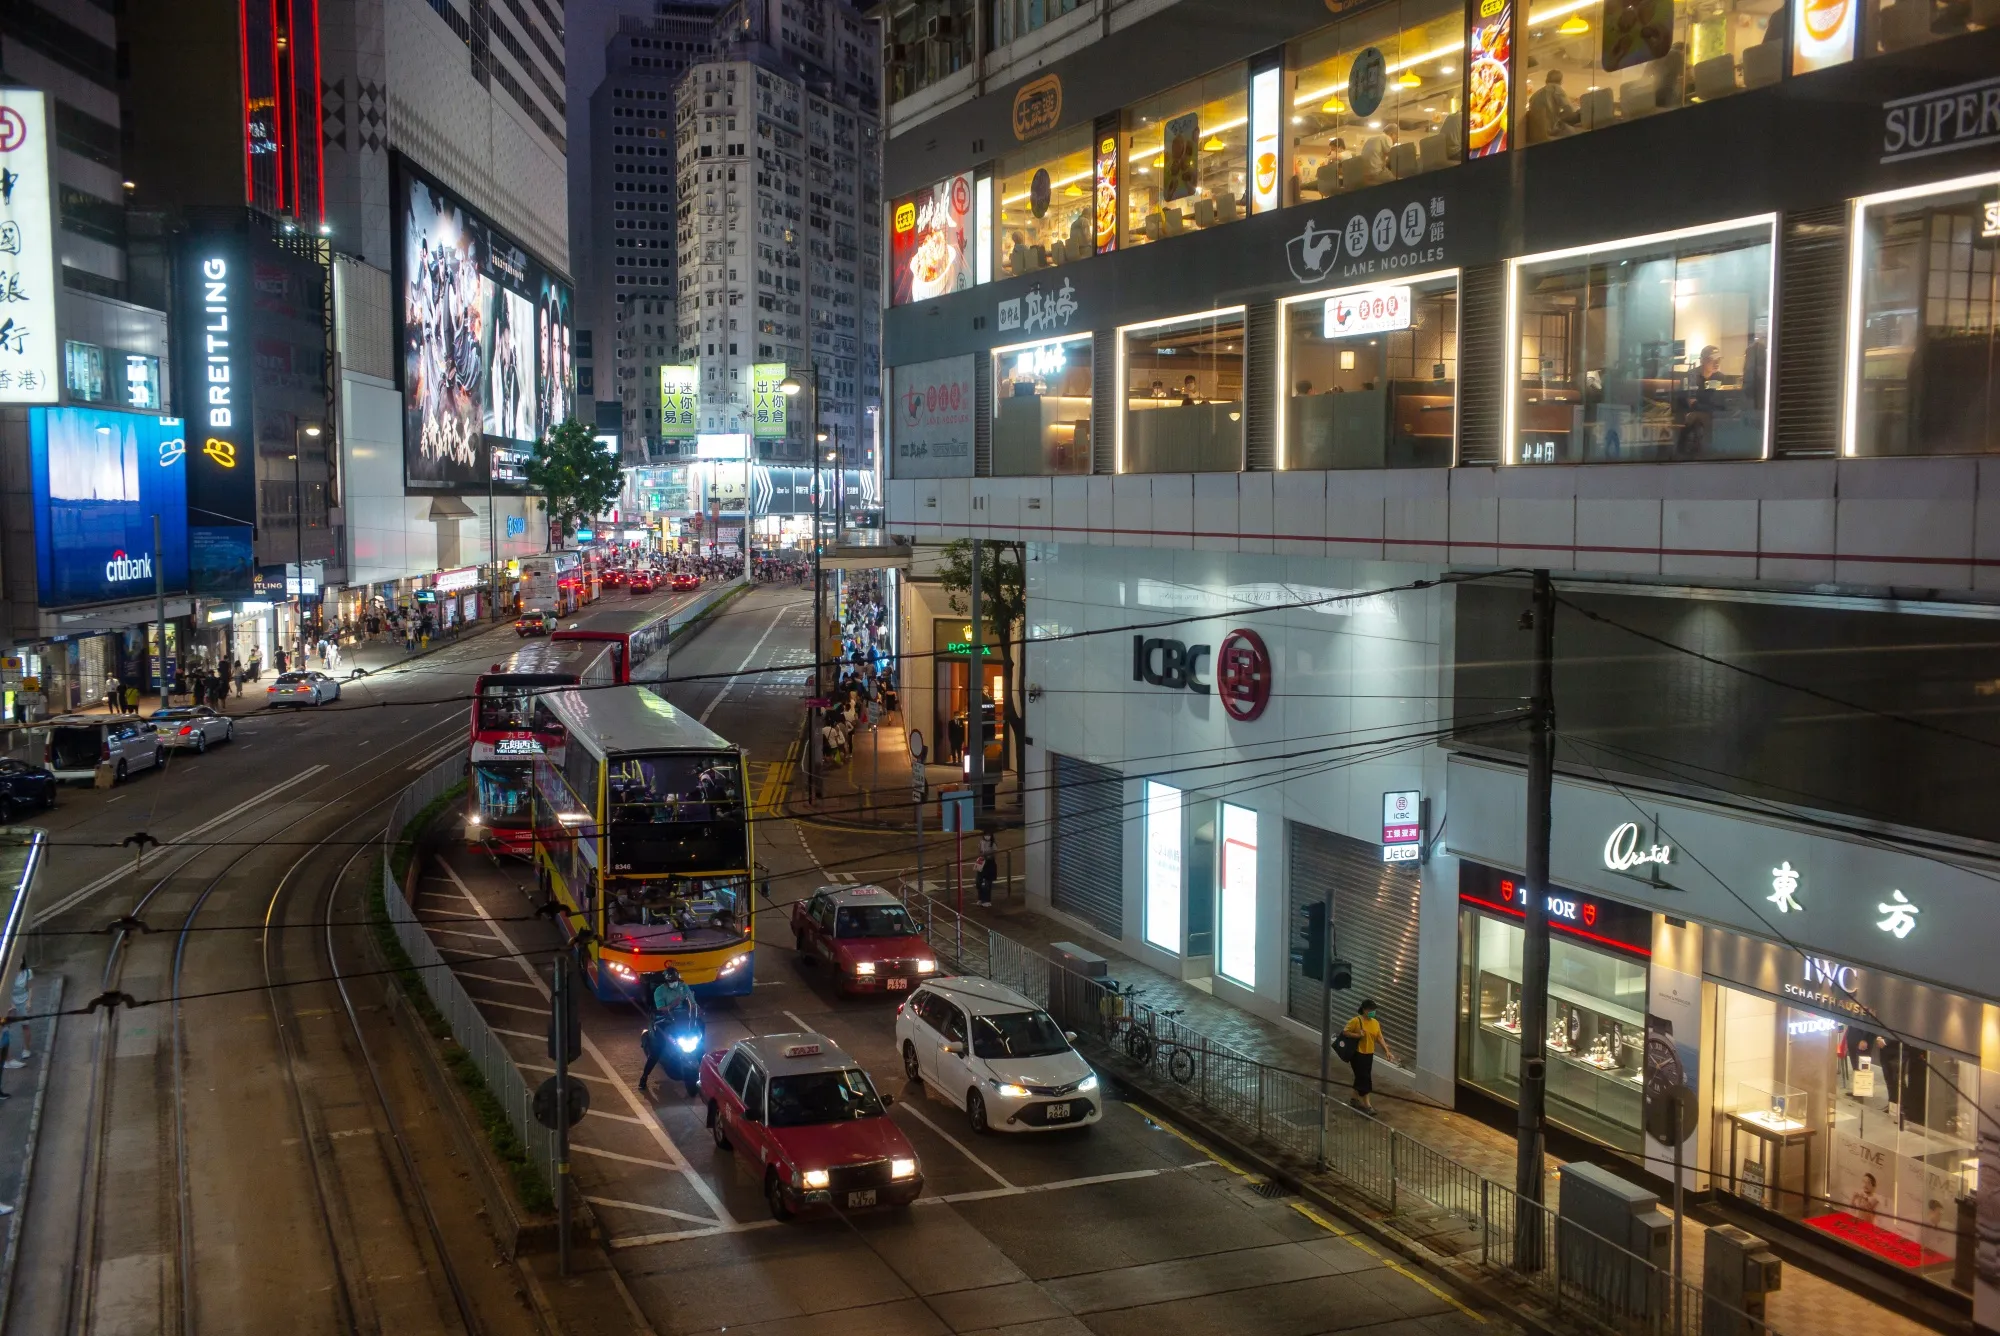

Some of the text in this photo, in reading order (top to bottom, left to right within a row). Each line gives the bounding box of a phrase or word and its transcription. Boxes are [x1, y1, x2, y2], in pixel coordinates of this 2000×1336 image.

[1884, 87, 2000, 152] SUPER
[1348, 207, 1423, 251] 巷仔見
[1430, 197, 1444, 242] 麵館
[1344, 247, 1444, 277] LANE NOODLES
[204, 258, 232, 427] BREITLING
[663, 381, 677, 424] 出入易
[679, 381, 693, 424] 迷你倉
[756, 380, 769, 423] 出入易
[771, 380, 784, 423] 迷你倉
[106, 552, 152, 582] citibank
[948, 642, 991, 655] ROLX
[1133, 635, 1211, 695] ICBC
[1519, 888, 1576, 919] TOR
[1803, 956, 1859, 994] IWC
[1784, 983, 1878, 1018] SCHAFFHAUSEN
[1788, 1018, 1836, 1035] TUDOR
[792, 1045, 819, 1055] TAXI
[1859, 1145, 1885, 1167] TIME
